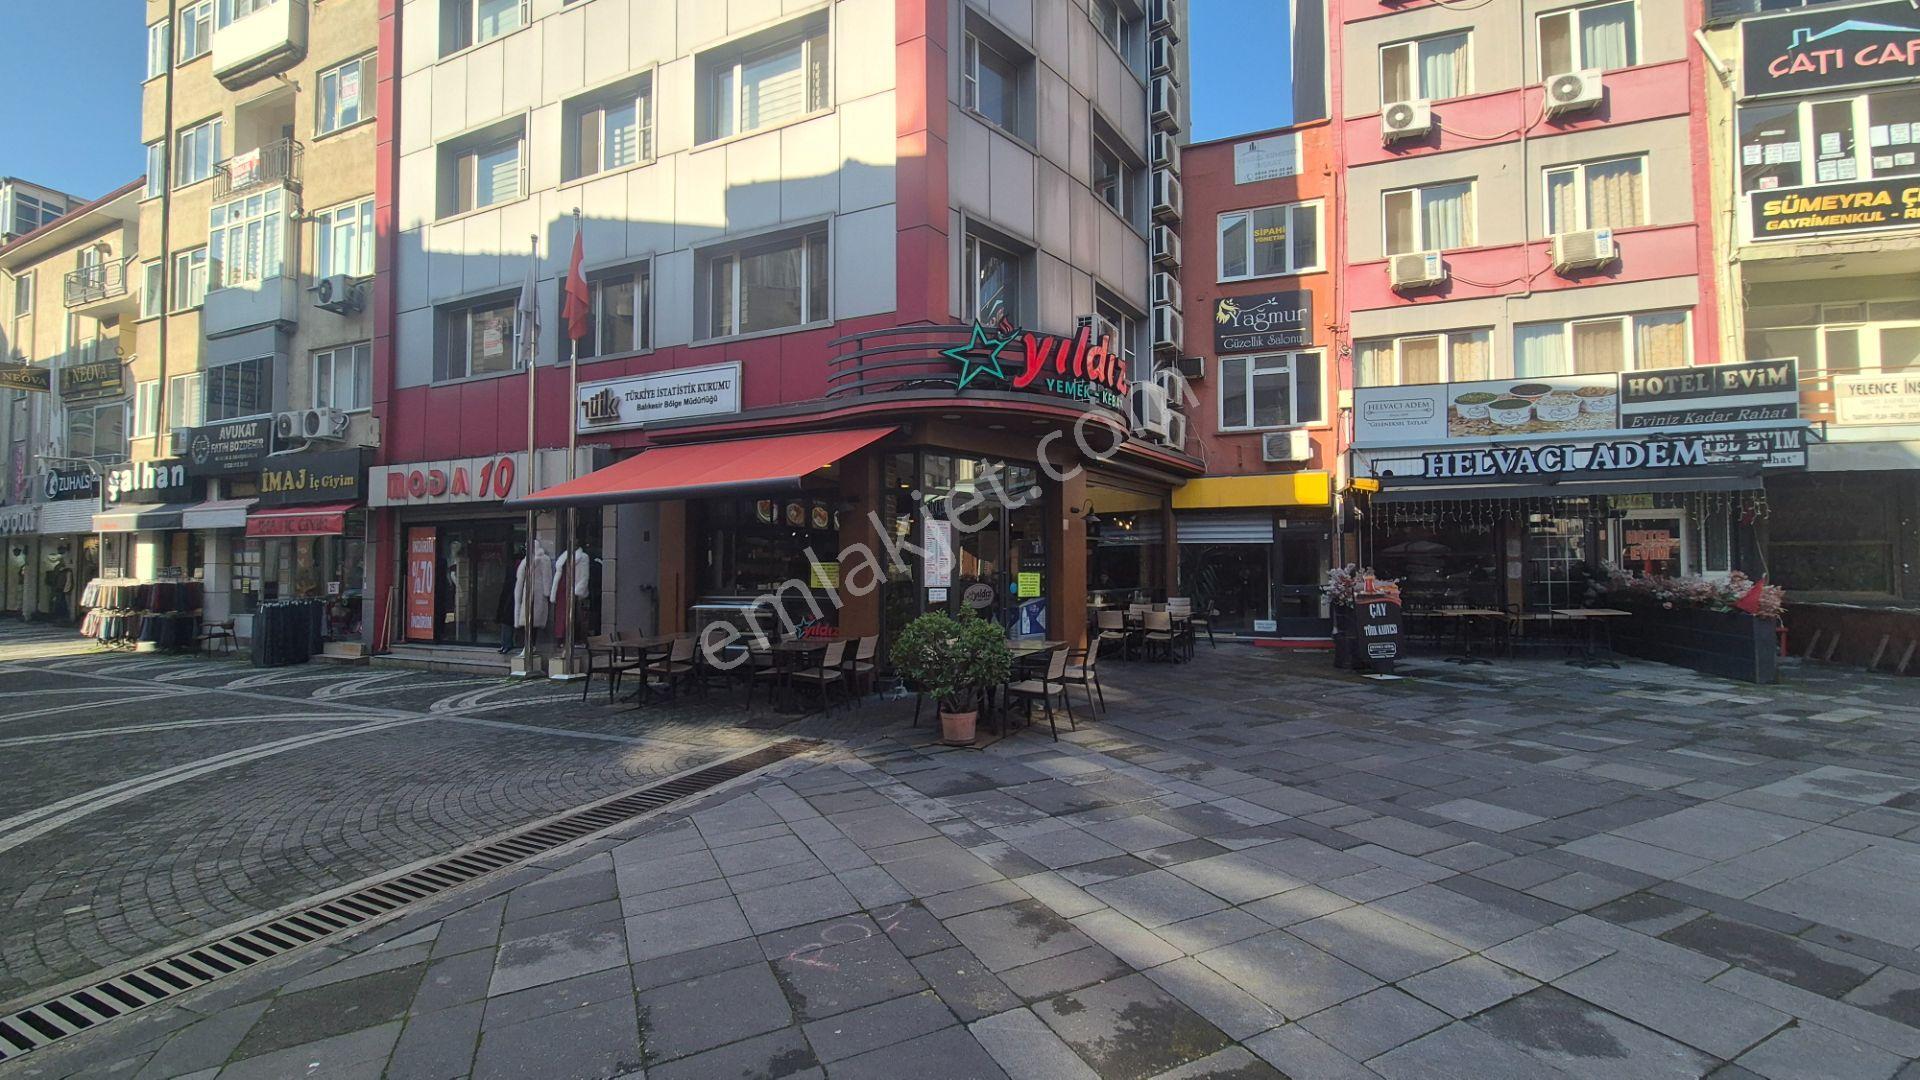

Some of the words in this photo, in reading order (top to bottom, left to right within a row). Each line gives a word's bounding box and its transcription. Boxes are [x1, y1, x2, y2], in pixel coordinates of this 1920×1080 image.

[1768, 48, 1844, 78] ÇATI
[1763, 190, 1892, 216] SÜMEYRA
[1902, 187, 1920, 208] Ç
[1765, 211, 1886, 230] GAYRİMENKUL
[1229, 307, 1307, 332] Yağmur
[1223, 335, 1264, 349] Güzellik
[1267, 332, 1303, 346] Salonu
[1013, 326, 1128, 396] yıldız
[3, 372, 47, 386] NEOVA
[72, 364, 107, 383] NEOVA
[624, 387, 655, 402] TÜRKİYE
[656, 382, 696, 398] İSTATİSTİK
[697, 380, 731, 393] KURUMU
[1046, 378, 1090, 399] YEMEK
[1628, 373, 1710, 397] HOTEL
[1848, 382, 1898, 395] YELENCE
[1404, 401, 1430, 409] ADEM
[1631, 414, 1679, 428] Eviniz
[1683, 411, 1734, 424] Kadar
[1736, 407, 1788, 421] Rahat
[219, 422, 258, 440] AVUKAT
[1424, 445, 1576, 478] HELVACI
[1590, 440, 1709, 471] ADEM
[261, 467, 307, 493] İMAJ
[321, 474, 354, 488] Giyim
[479, 456, 516, 498] 10
[412, 560, 433, 594] %70
[1369, 602, 1387, 618] ÇAY
